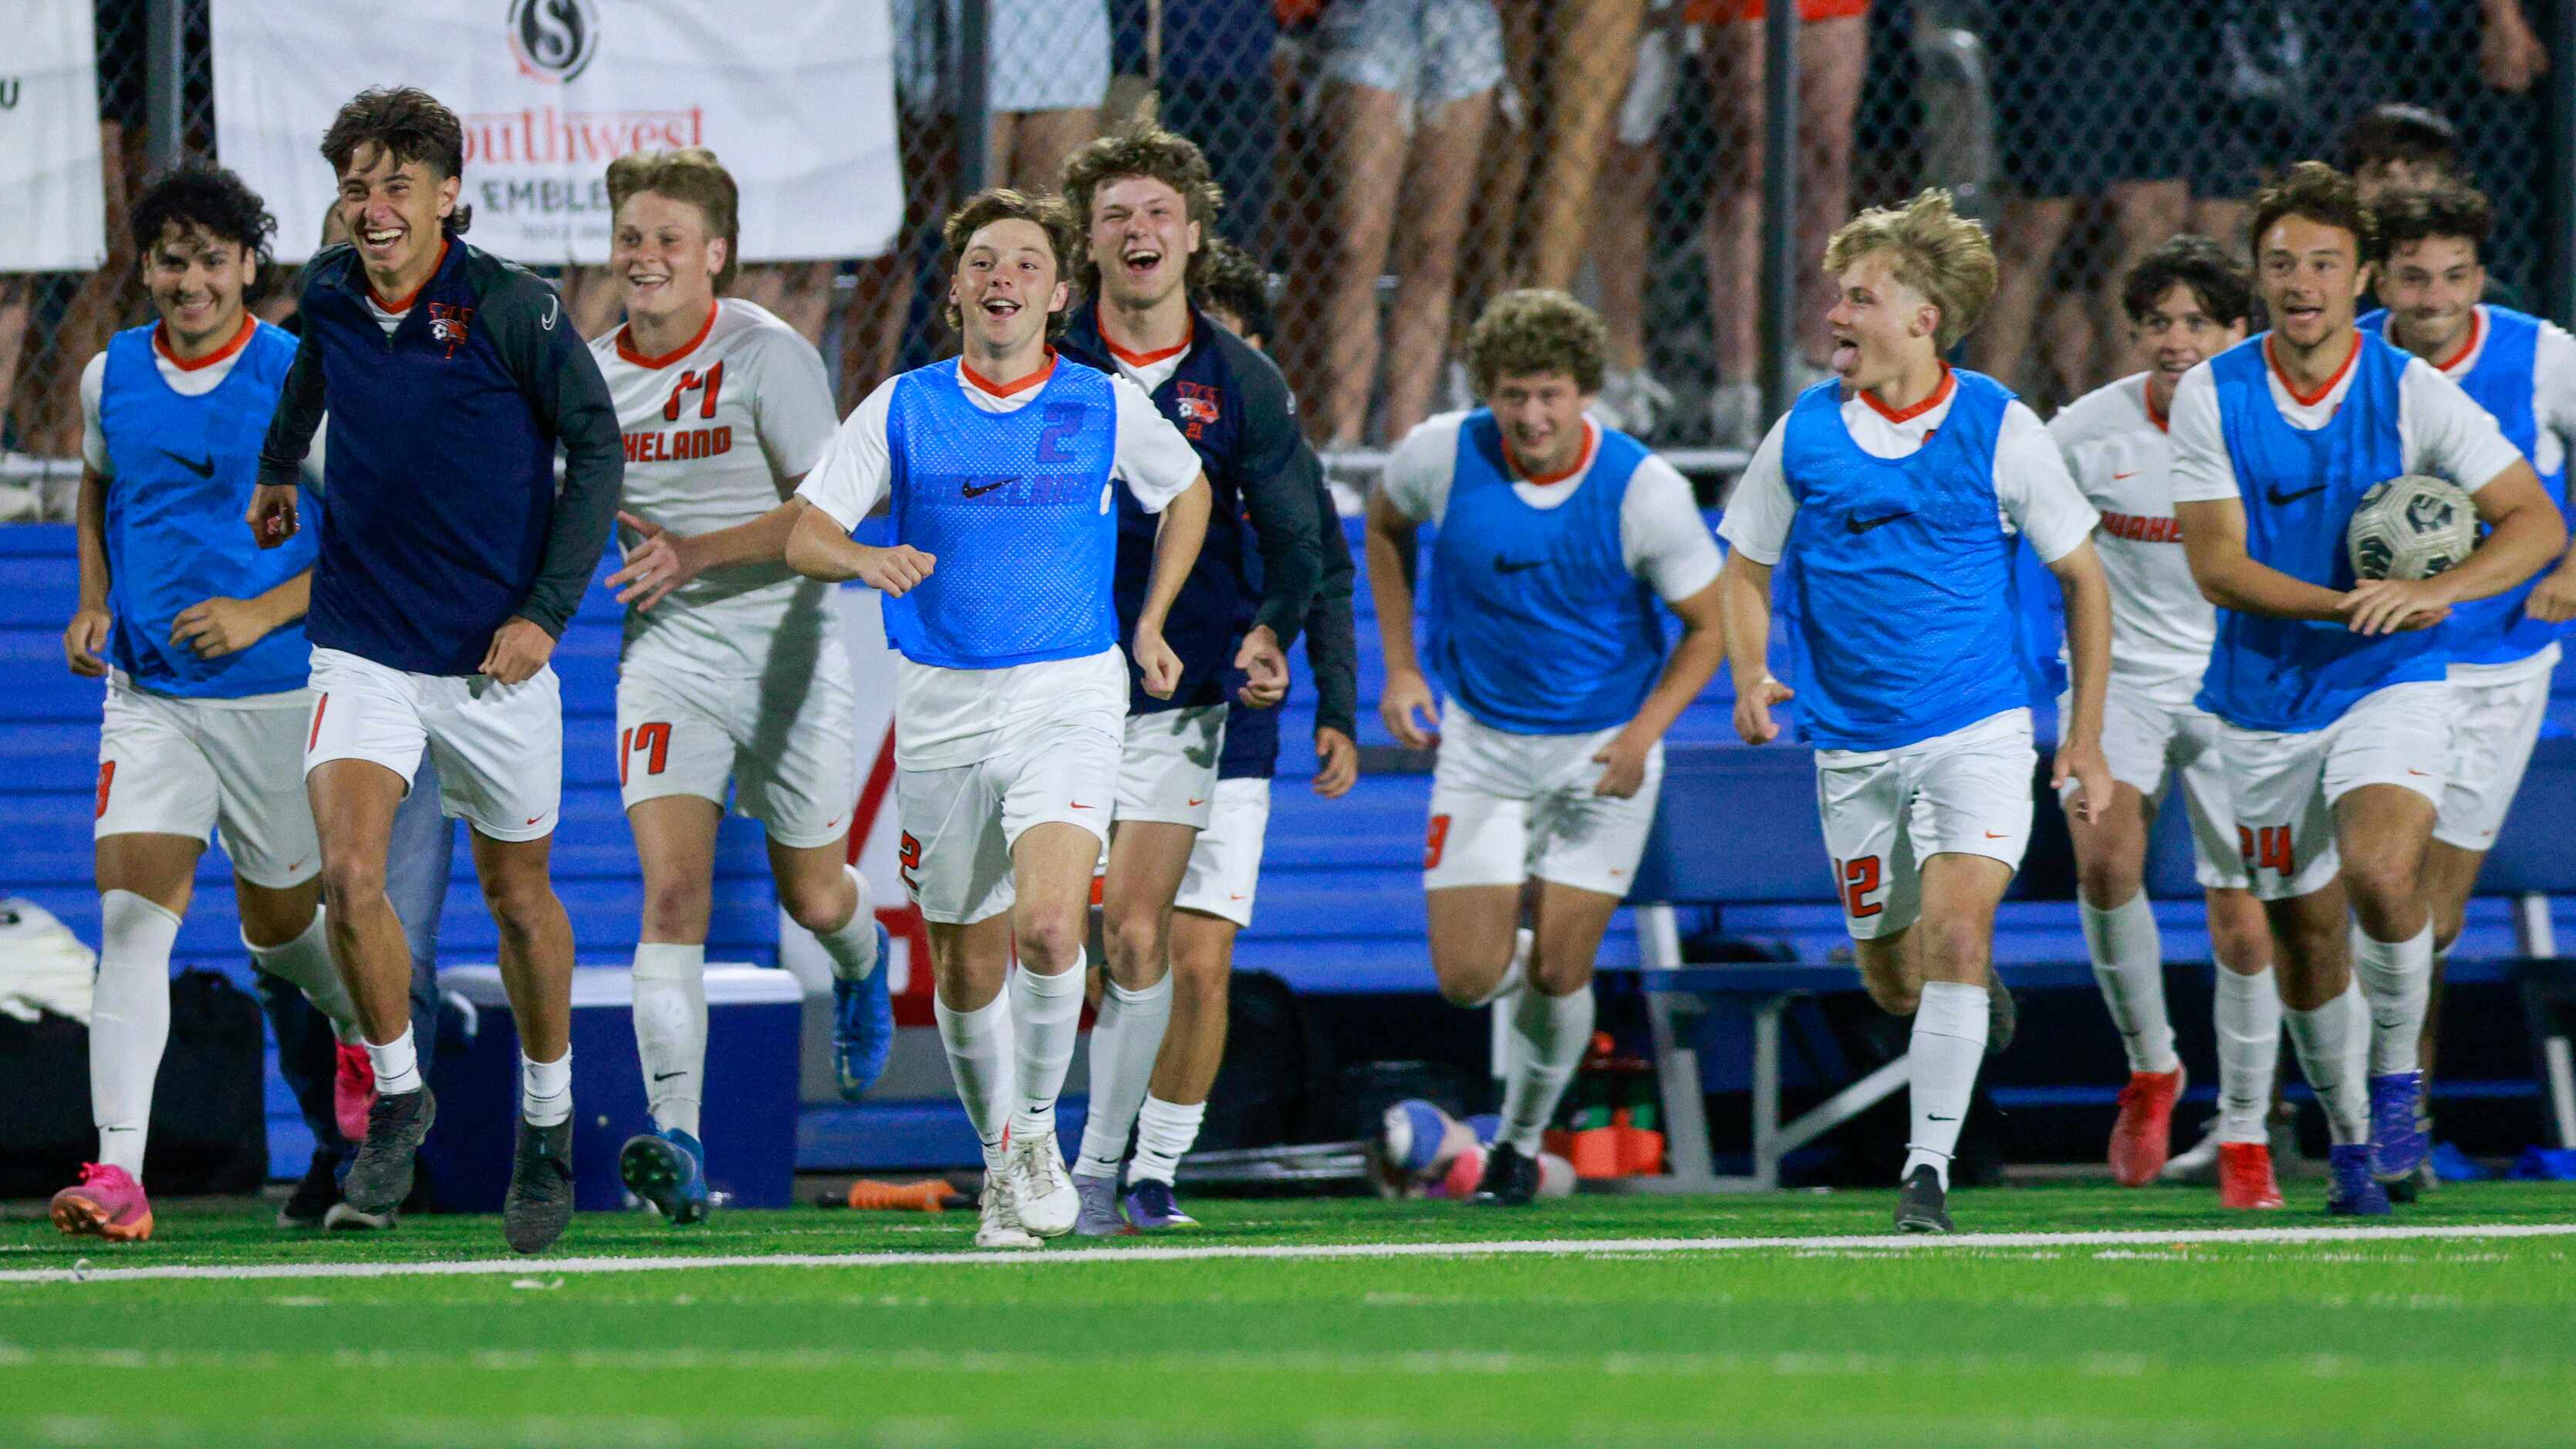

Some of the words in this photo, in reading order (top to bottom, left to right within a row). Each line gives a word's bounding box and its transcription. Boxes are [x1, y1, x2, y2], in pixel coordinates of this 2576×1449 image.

[462, 106, 703, 164] outhwest
[481, 178, 610, 214] EMBLE
[622, 425, 731, 463] KELAND
[1035, 401, 1087, 463] 2
[2100, 510, 2184, 543] WAKE
[621, 721, 672, 787] 17
